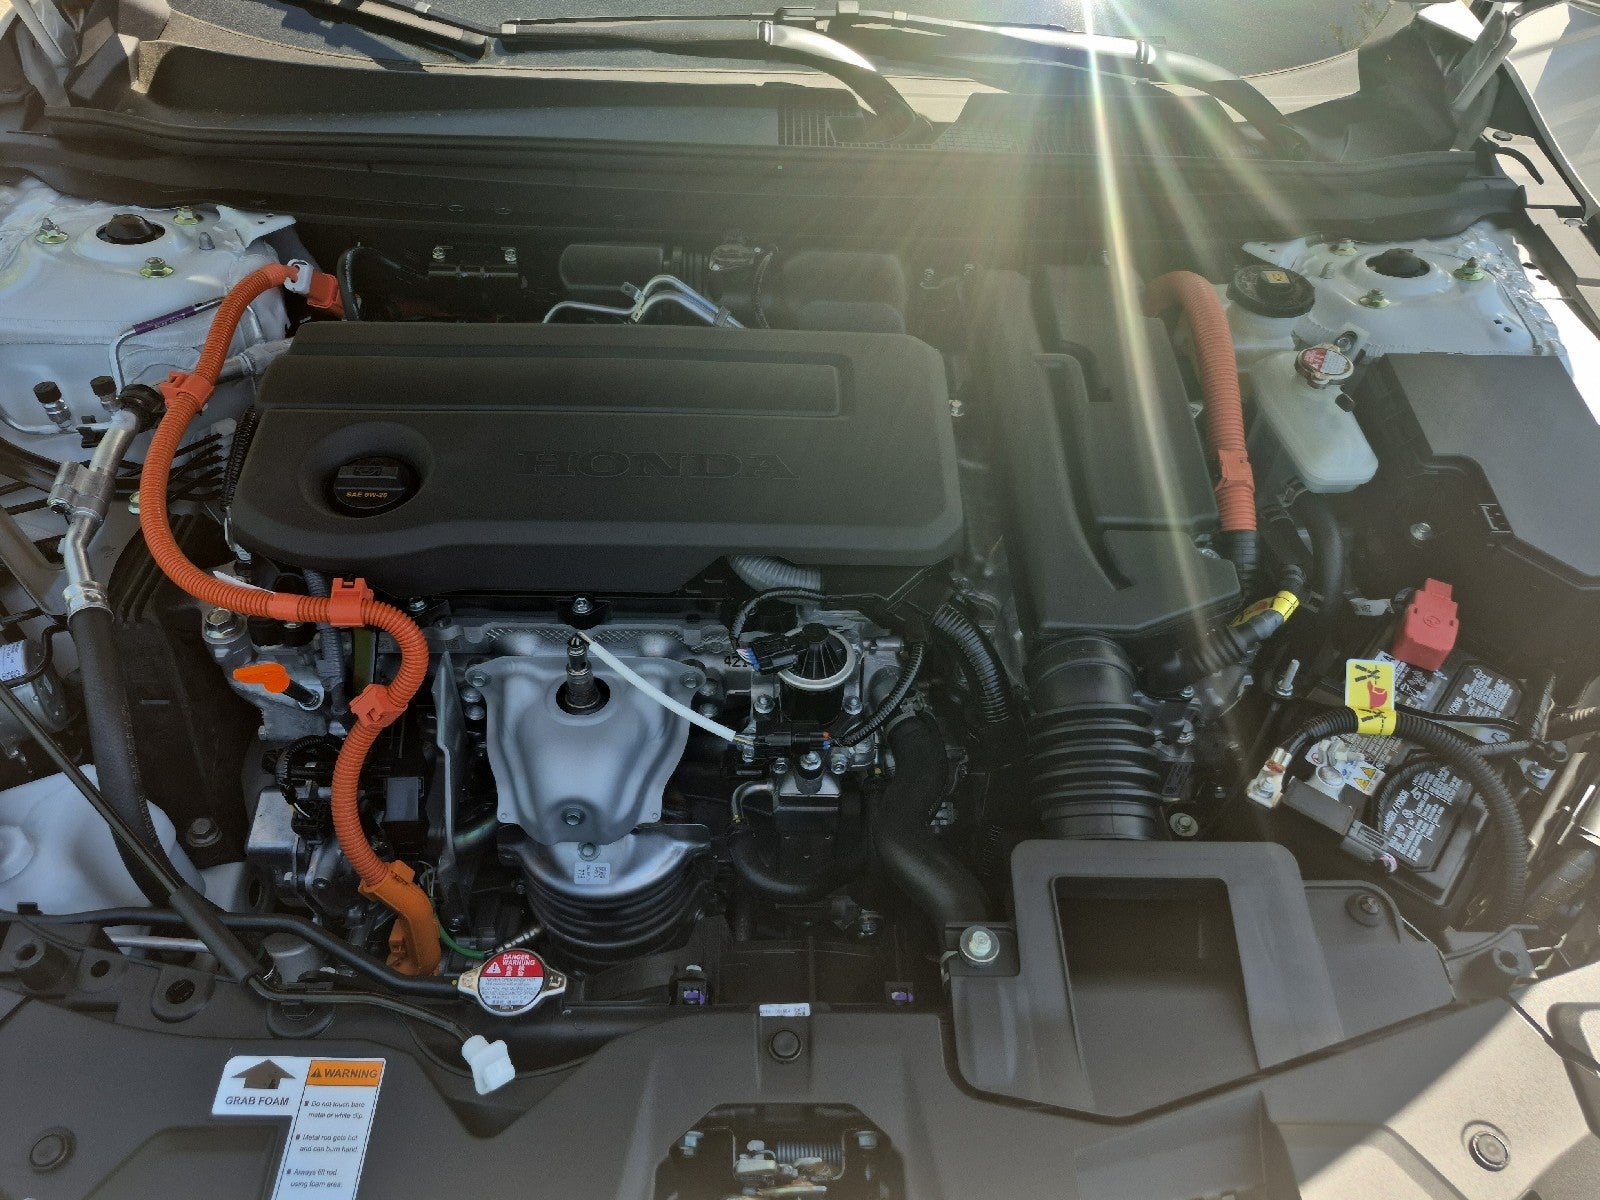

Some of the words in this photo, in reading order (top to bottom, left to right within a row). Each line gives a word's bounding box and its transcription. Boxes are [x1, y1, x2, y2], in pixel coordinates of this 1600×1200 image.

[515, 451, 800, 480] HONDA
[324, 1068, 378, 1078] WARNING
[225, 1096, 256, 1105] GRAB
[258, 1096, 290, 1106] FOAM
